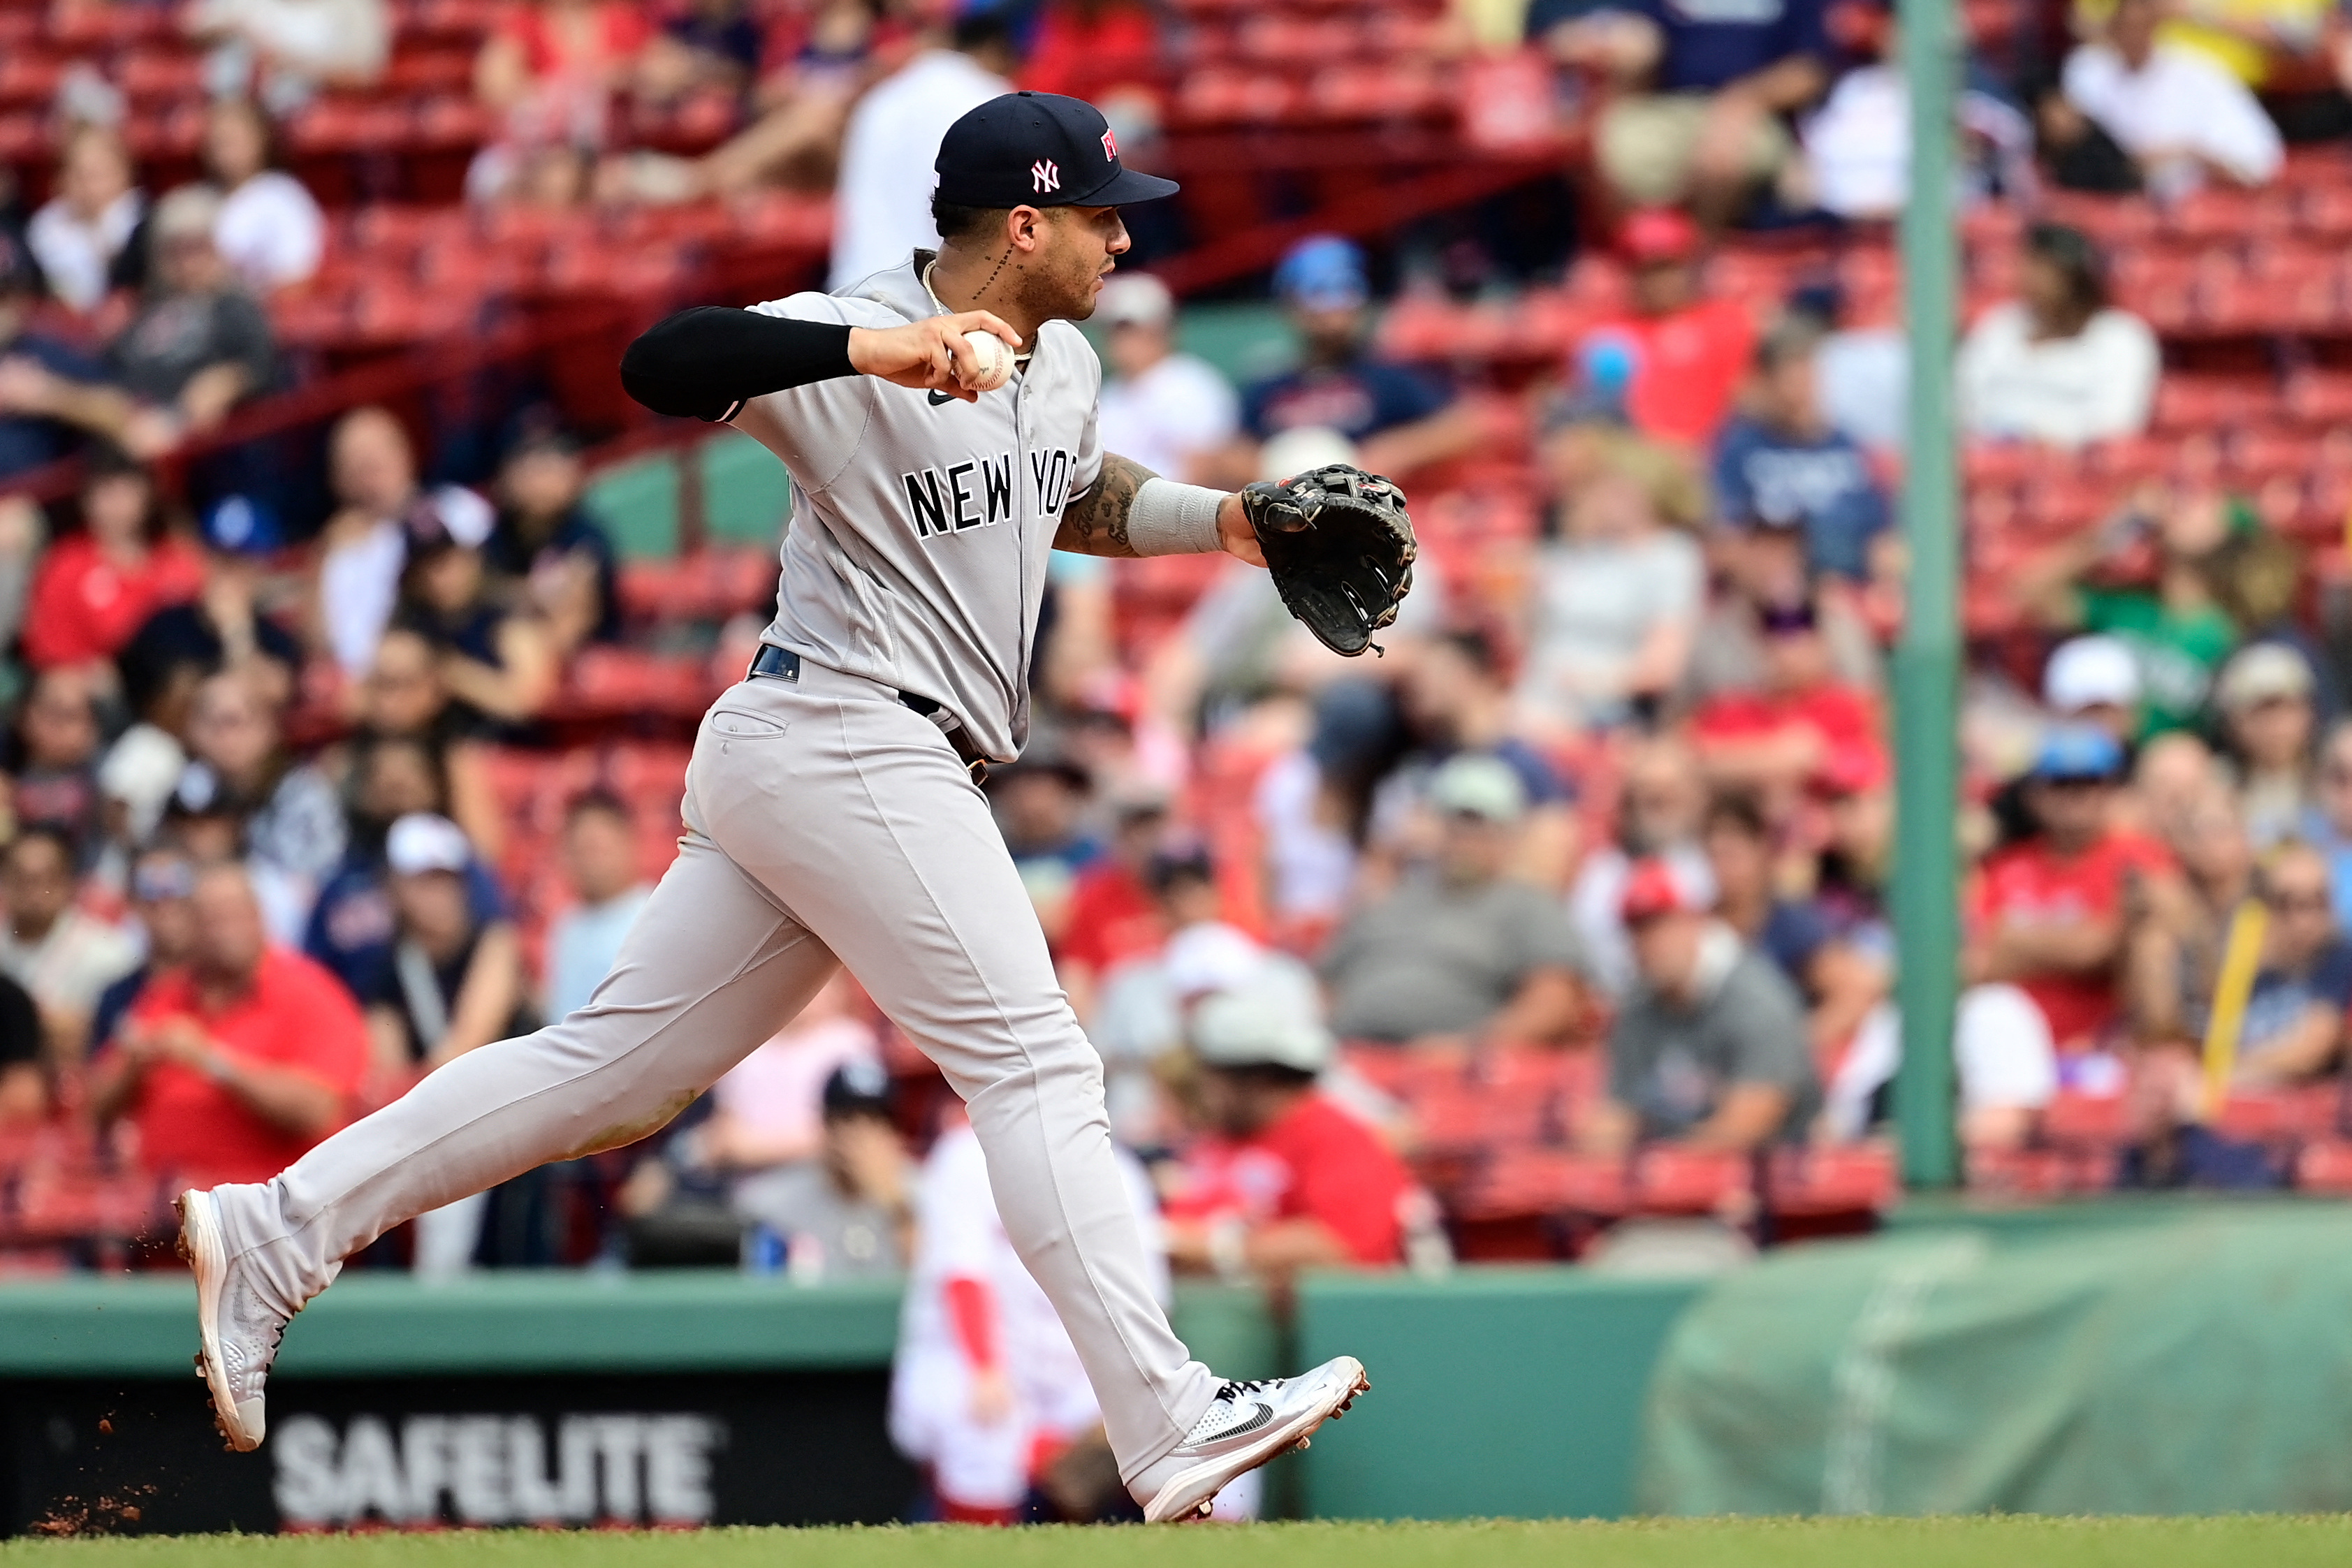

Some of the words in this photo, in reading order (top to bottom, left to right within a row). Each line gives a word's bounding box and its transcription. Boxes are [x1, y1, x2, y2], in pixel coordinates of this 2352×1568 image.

[1030, 157, 1061, 194] NY
[902, 450, 1012, 541] NEW
[274, 1413, 717, 1523] SAFELITE
